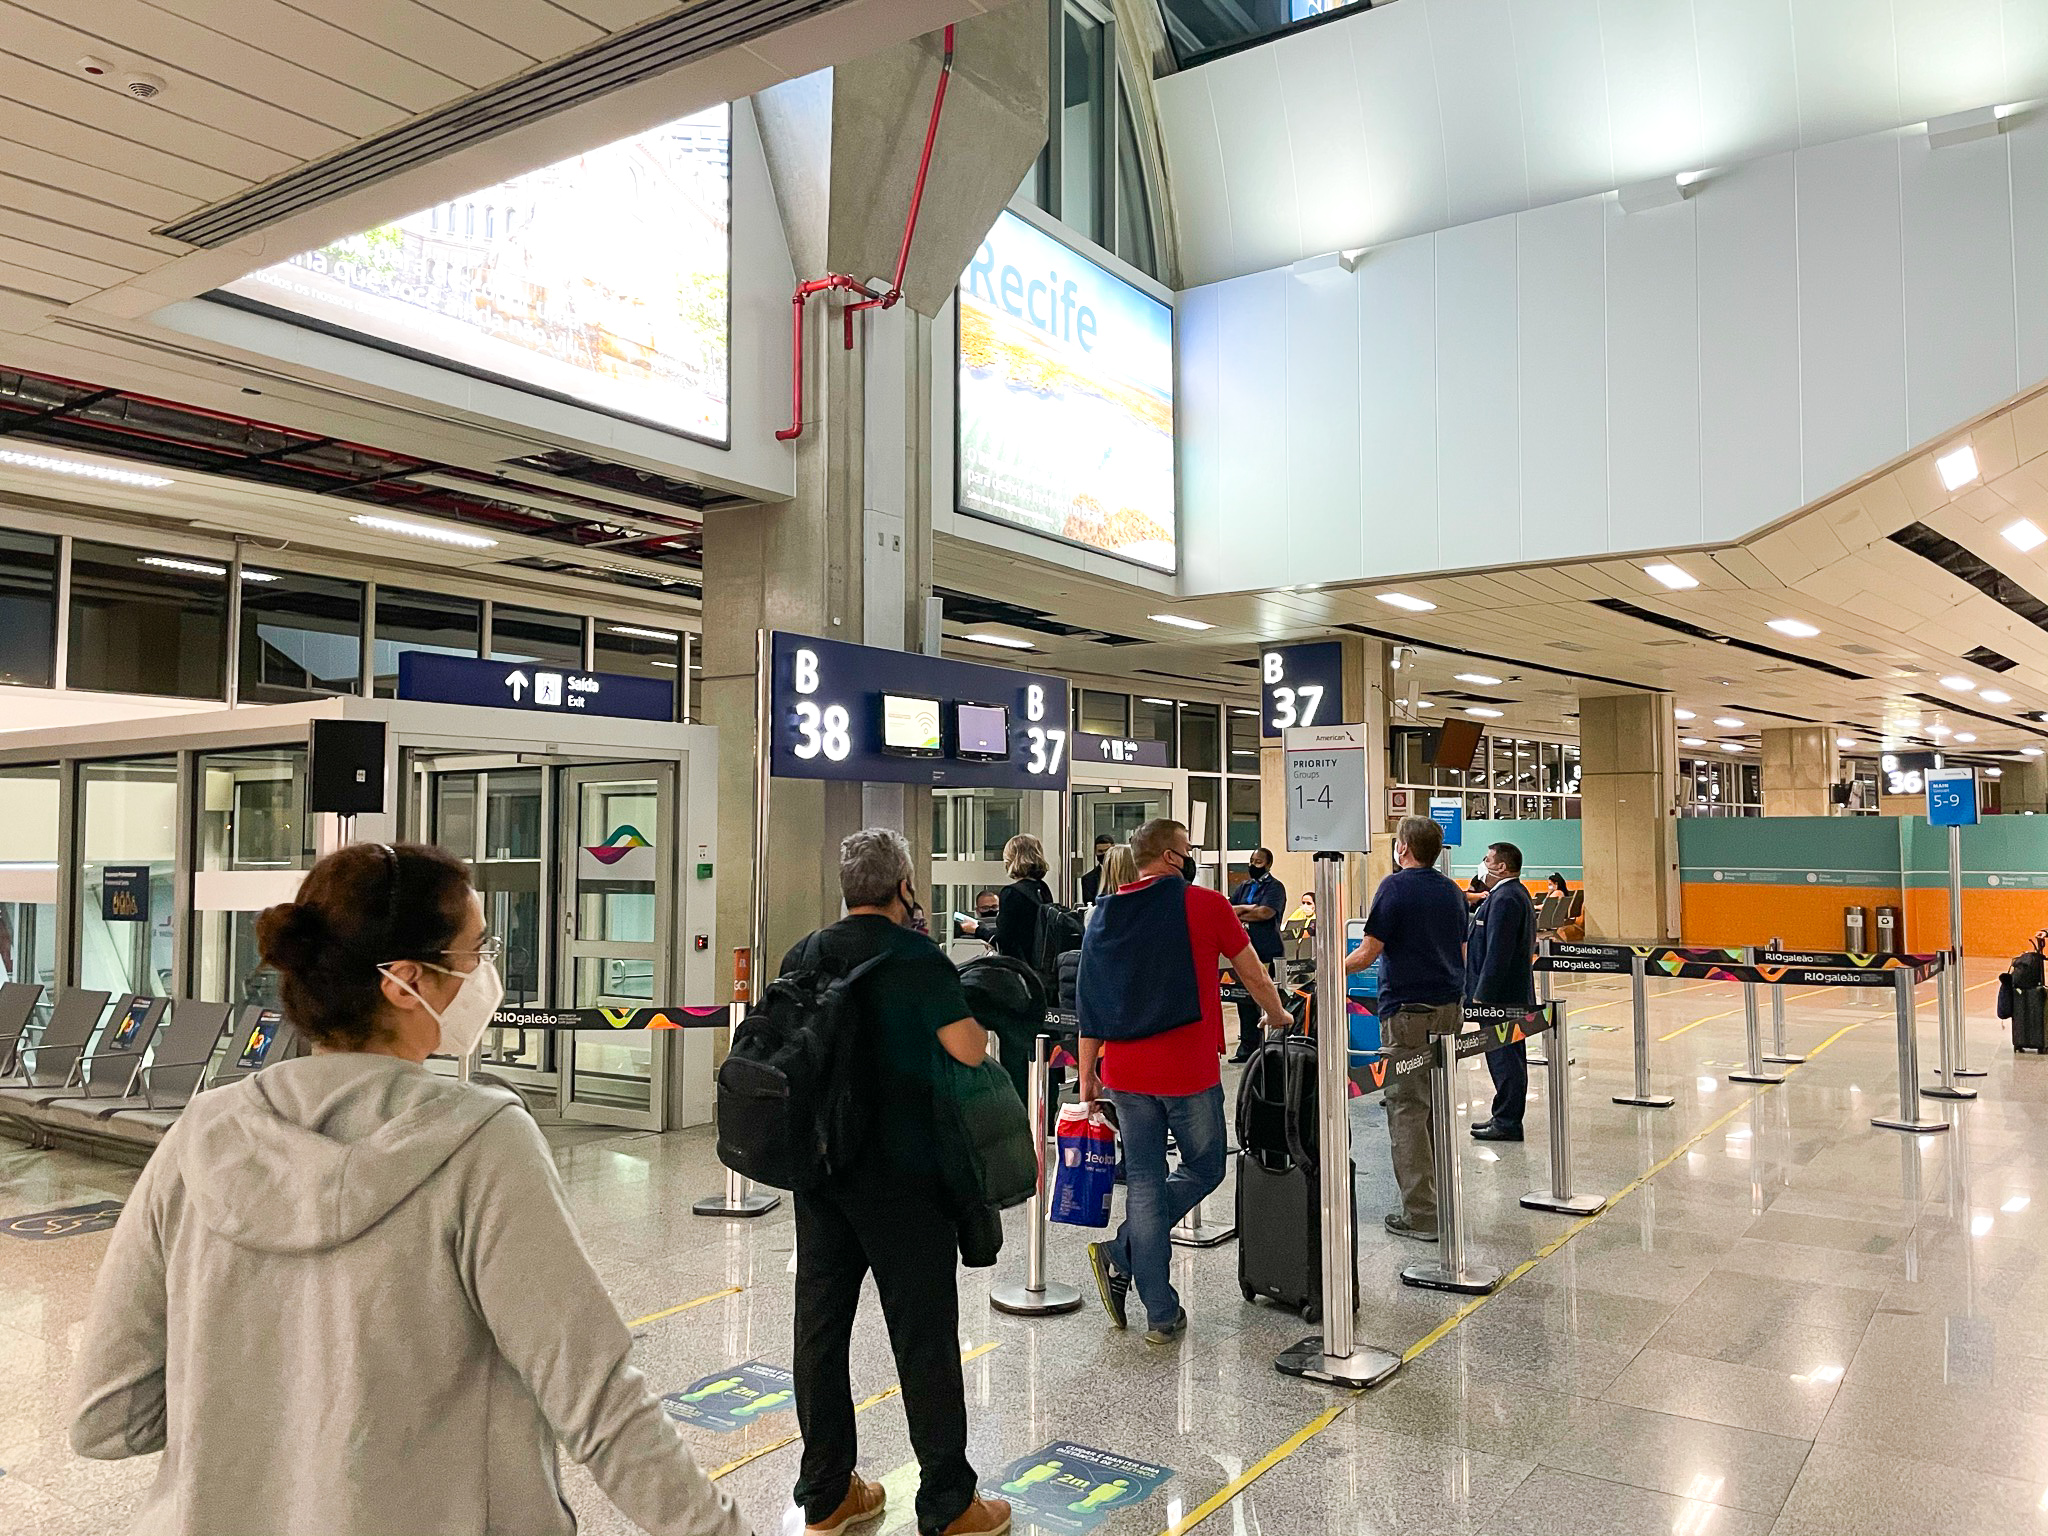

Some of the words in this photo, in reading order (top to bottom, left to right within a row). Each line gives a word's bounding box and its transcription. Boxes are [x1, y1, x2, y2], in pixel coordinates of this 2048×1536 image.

[256, 270, 293, 292] todos
[294, 284, 311, 297] os
[970, 239, 1097, 354] Recife
[967, 469, 991, 489] para
[795, 649, 820, 695] B
[1263, 652, 1284, 684] B
[567, 676, 599, 693] Saída
[567, 695, 585, 708] Exit
[1027, 684, 1045, 722] B
[1272, 685, 1324, 729] 37
[793, 701, 851, 762] 38
[1316, 734, 1346, 742] American
[1027, 727, 1066, 775] 37
[1293, 759, 1338, 769] PRIORITY
[1882, 755, 1897, 772] B
[1293, 770, 1320, 779] Groups
[1888, 770, 1922, 794] 36
[1295, 784, 1334, 810] 1-4
[1934, 794, 1960, 808] 5-9
[493, 1012, 558, 1026] RIOgaleão
[1462, 1006, 1505, 1019] galeão
[1057, 1473, 1091, 1489] 2m
